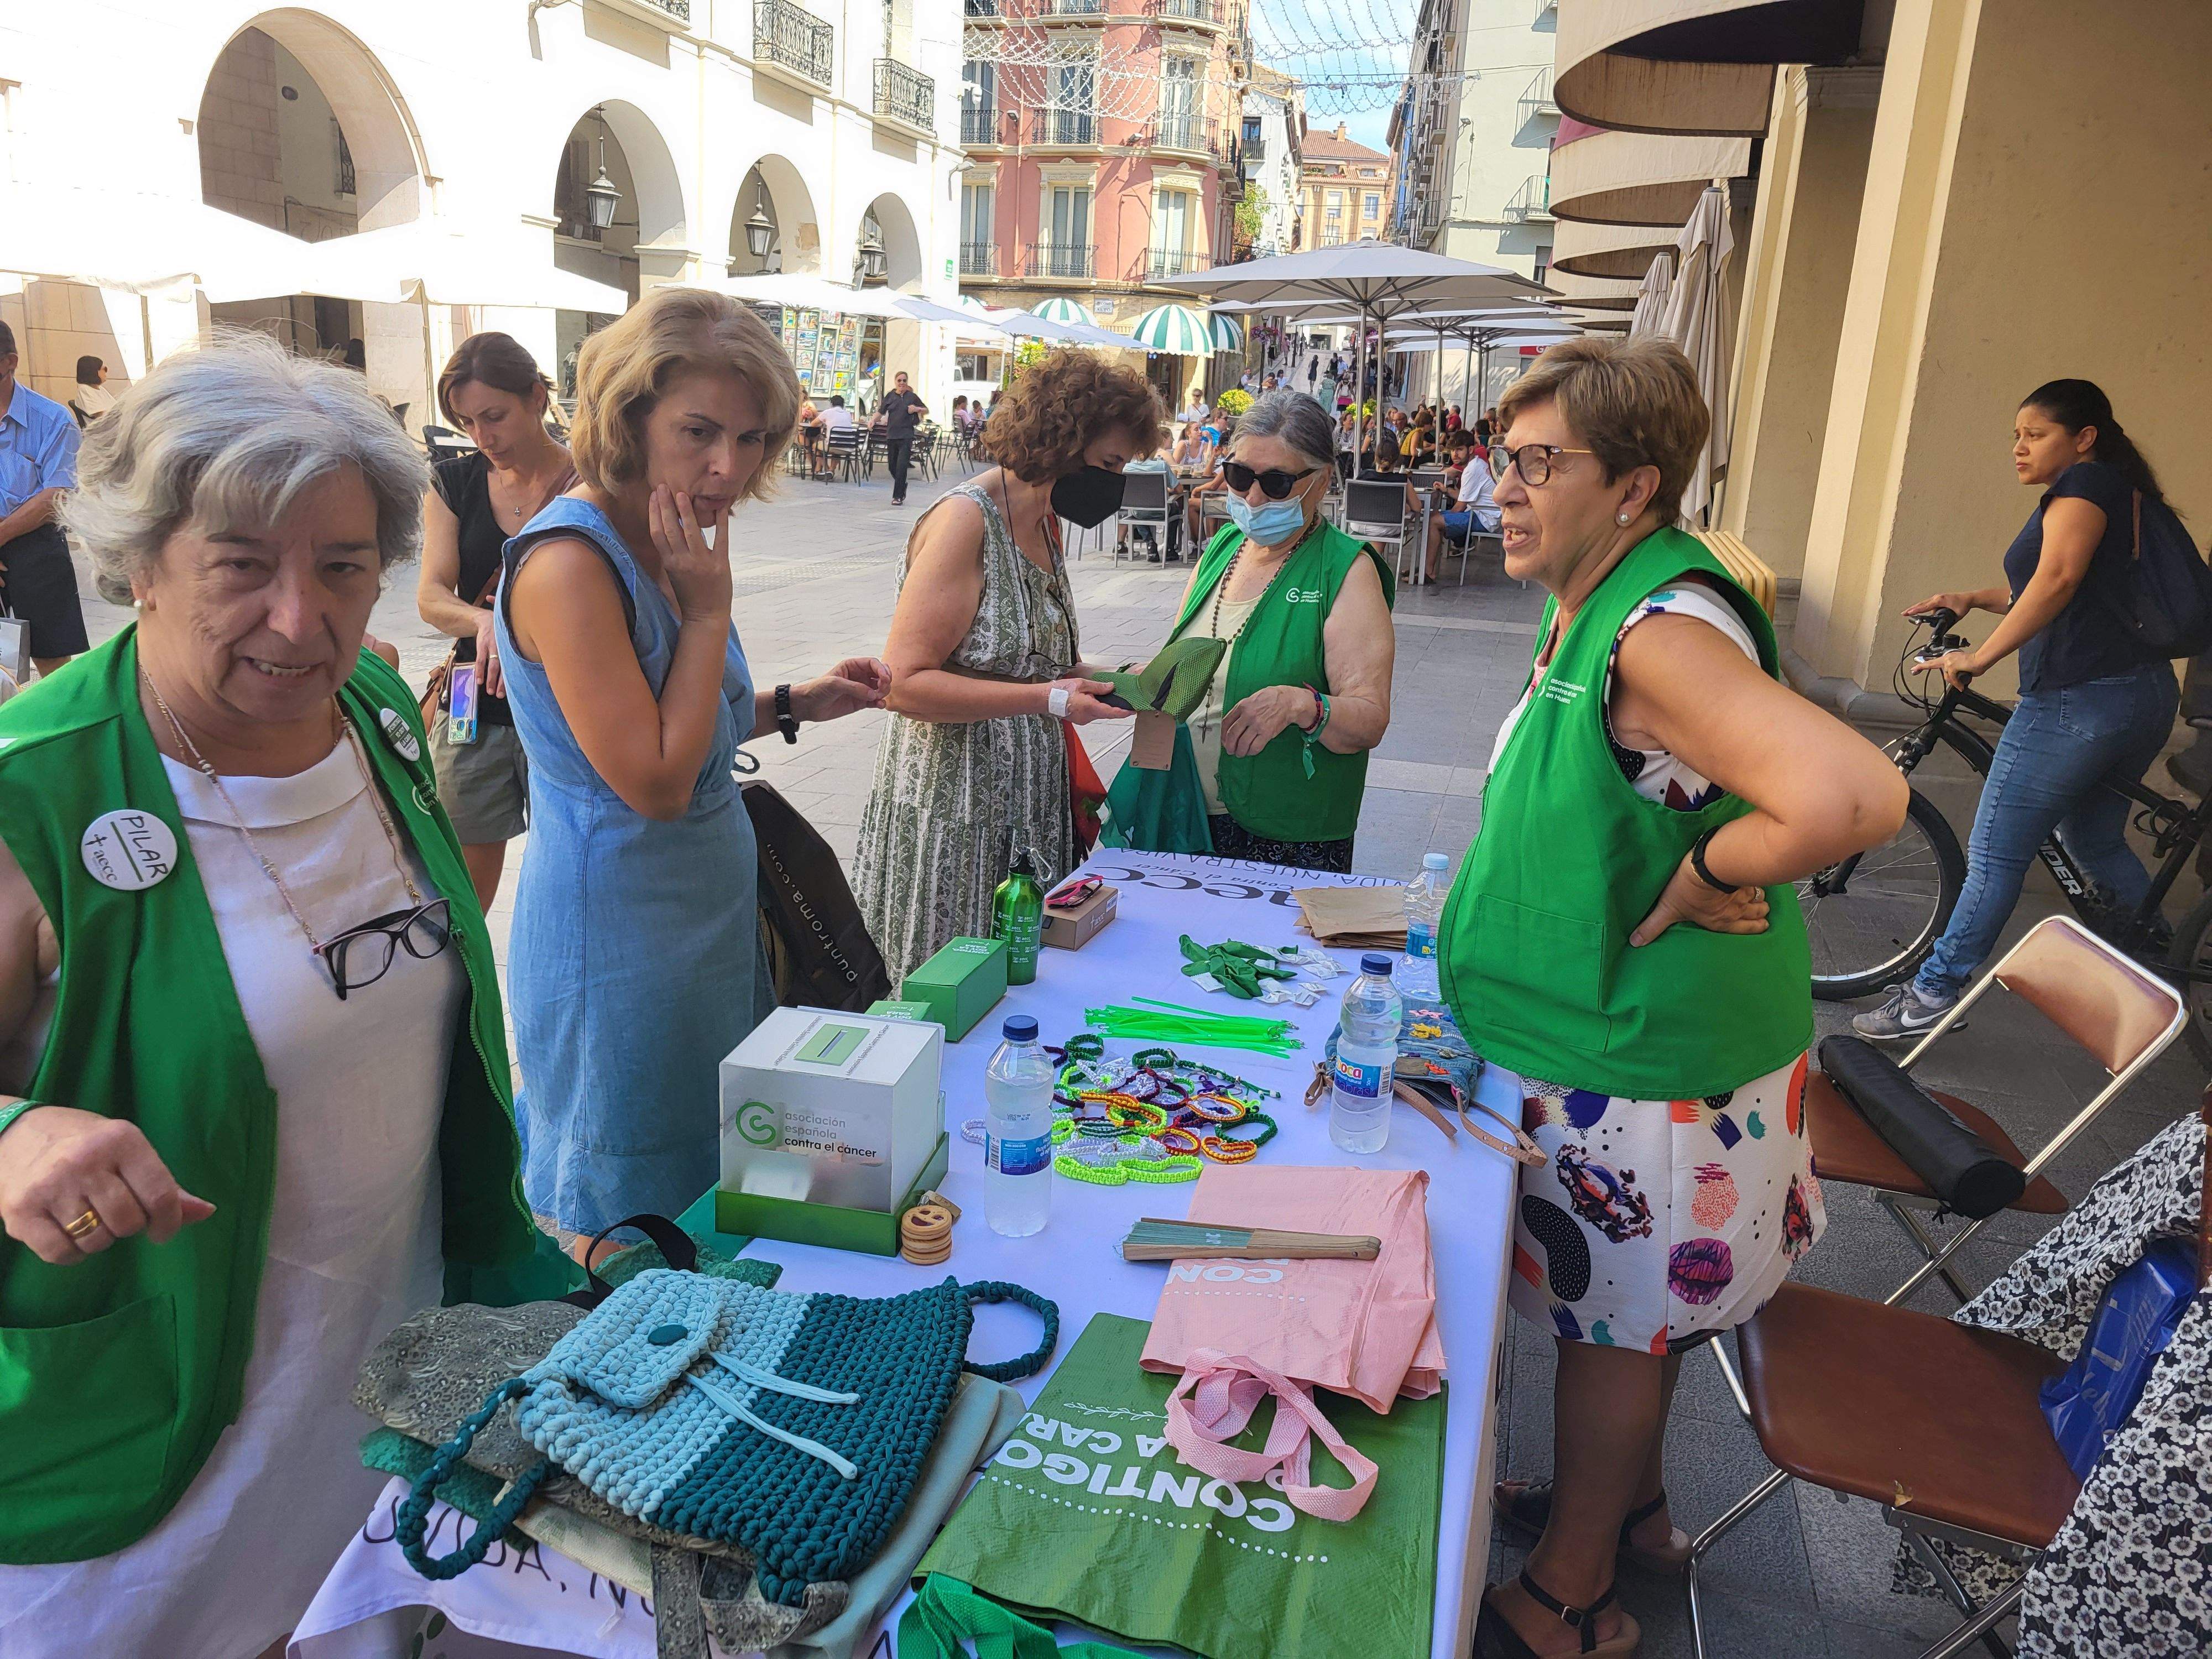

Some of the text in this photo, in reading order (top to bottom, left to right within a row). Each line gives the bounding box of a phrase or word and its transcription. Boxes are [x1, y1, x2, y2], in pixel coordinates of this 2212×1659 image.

[120, 816, 168, 878] PILAR
[1110, 863, 1197, 876] Cáncer
[1084, 866, 1302, 908] aecc
[1230, 876, 1295, 890] Contra
[766, 843, 858, 983] puntroma.com
[785, 1112, 846, 1128] asociación
[785, 1125, 837, 1139] española
[784, 1137, 877, 1158] contra el cáncer
[993, 1439, 1295, 1532] CONTIGO
